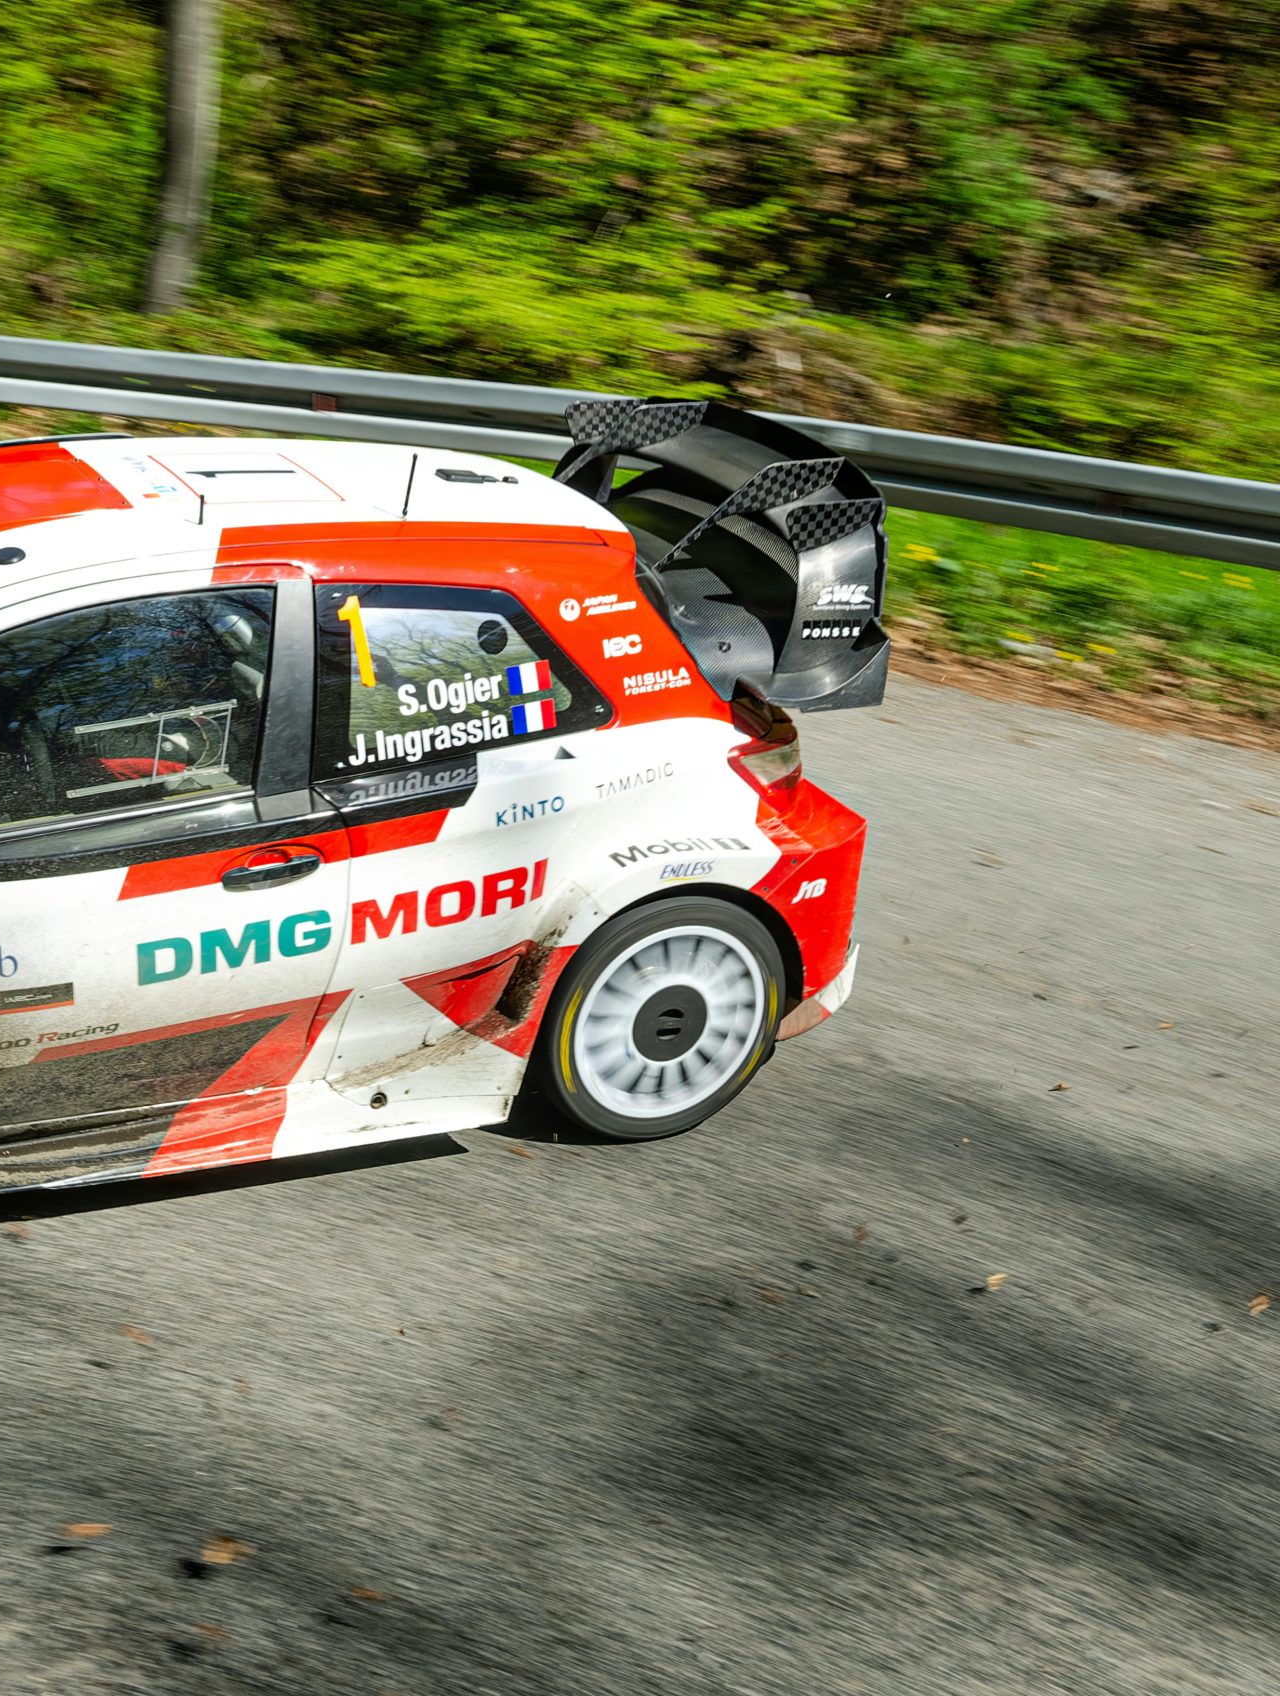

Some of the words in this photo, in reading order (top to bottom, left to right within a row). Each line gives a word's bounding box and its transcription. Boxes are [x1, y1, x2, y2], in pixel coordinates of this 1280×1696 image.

[337, 595, 376, 688] 1
[397, 672, 502, 716] S.Ogier
[623, 667, 690, 688] NISULA
[348, 710, 509, 767] J.Ingrassia
[596, 762, 675, 799] TAMADIC
[609, 838, 713, 868] Mobil
[659, 860, 716, 880] ENDLESS
[791, 878, 828, 904] JTB
[136, 909, 332, 986] DMG
[350, 857, 549, 946] MORI
[36, 1022, 120, 1044] Racing
